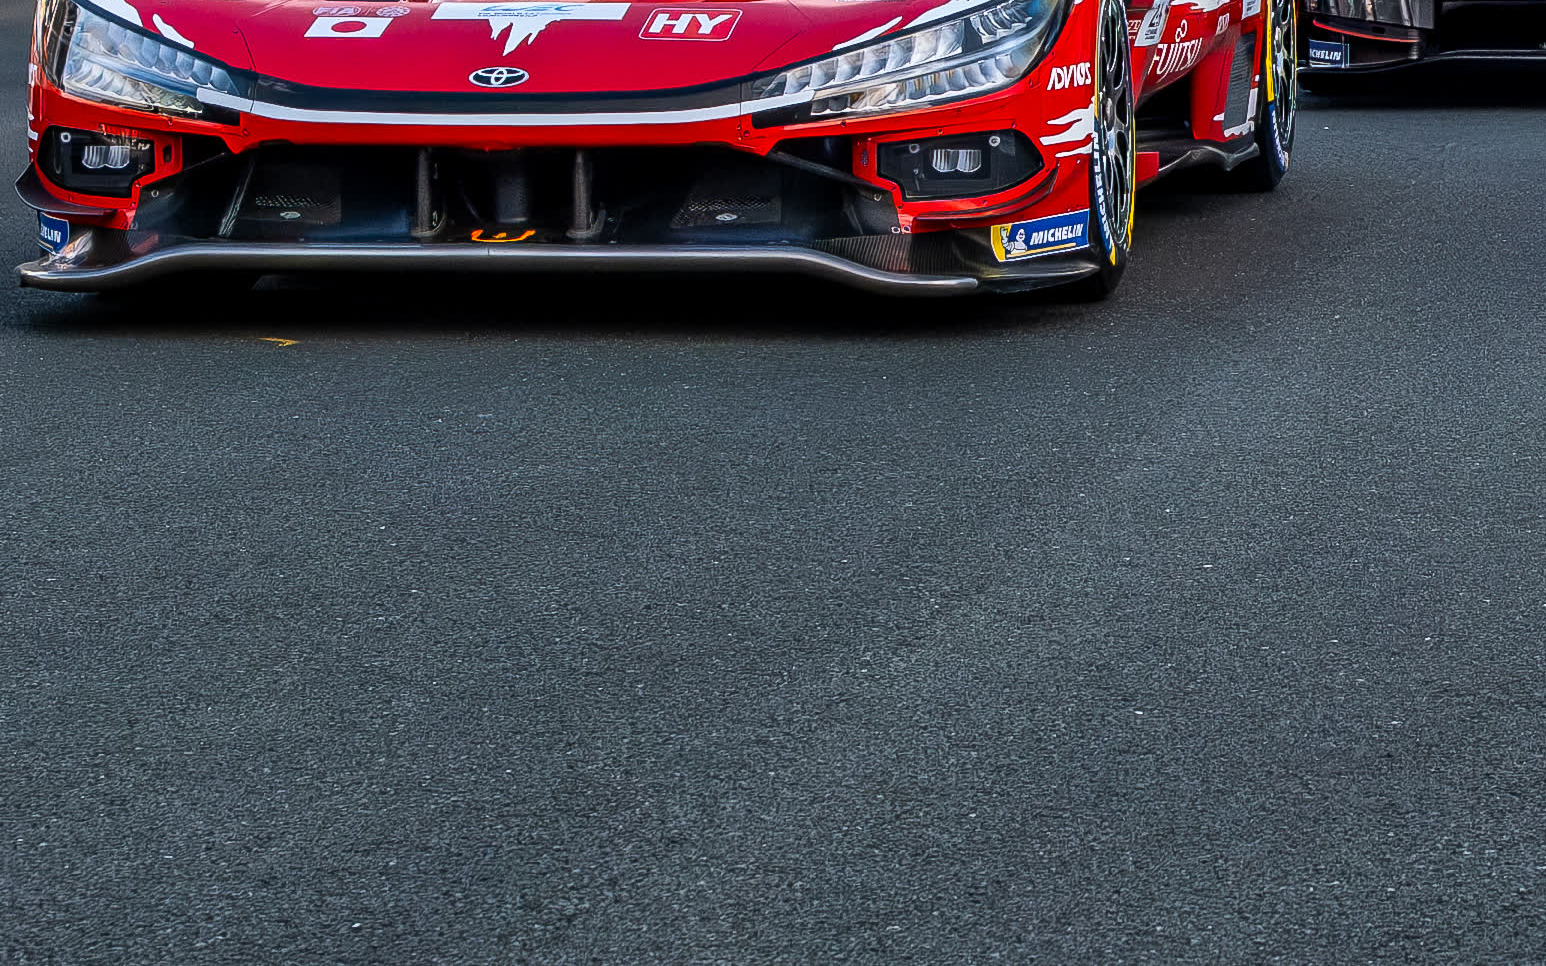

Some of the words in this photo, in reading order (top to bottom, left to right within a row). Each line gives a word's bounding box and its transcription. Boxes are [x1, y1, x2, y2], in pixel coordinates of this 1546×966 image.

[649, 14, 725, 34] HY
[1148, 36, 1203, 78] FUJITSU
[1029, 223, 1084, 246] MICHELIN
